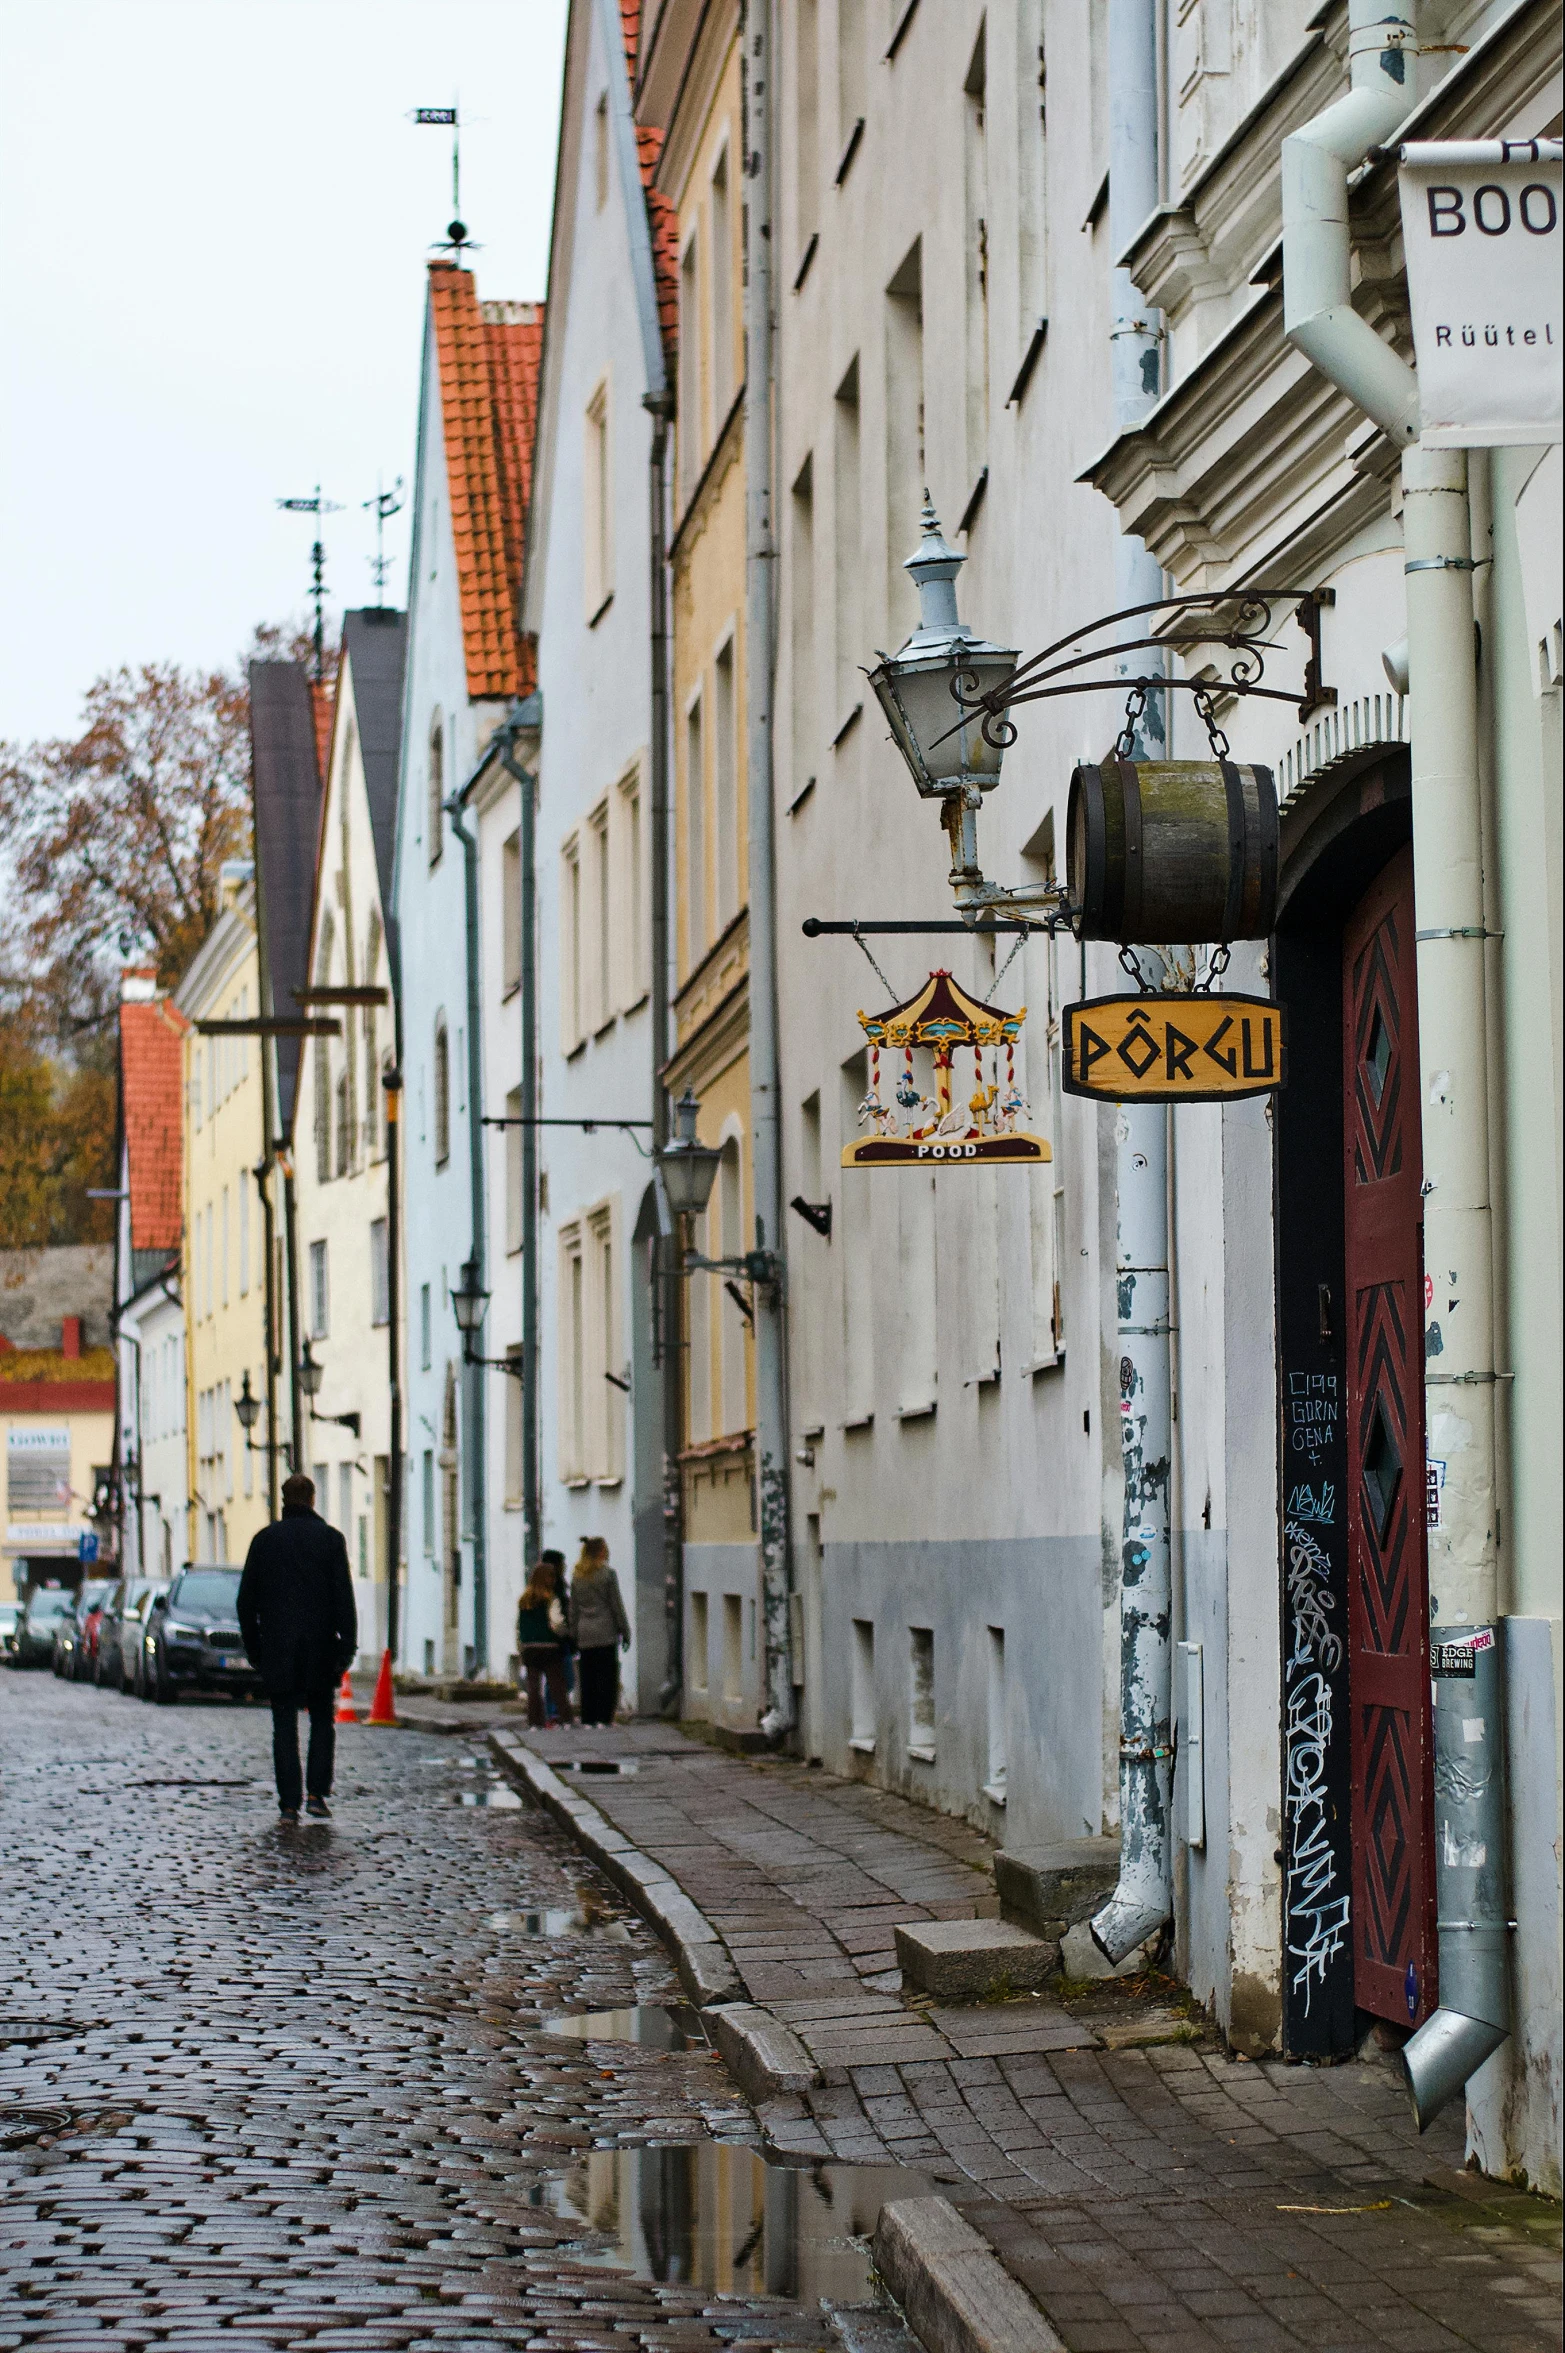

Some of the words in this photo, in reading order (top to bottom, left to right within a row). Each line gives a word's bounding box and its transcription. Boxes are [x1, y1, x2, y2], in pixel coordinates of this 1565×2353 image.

[917, 1143, 977, 1159] POOD
[1442, 1647, 1473, 1658] EDGE
[1442, 1658, 1473, 1669] BREWING
